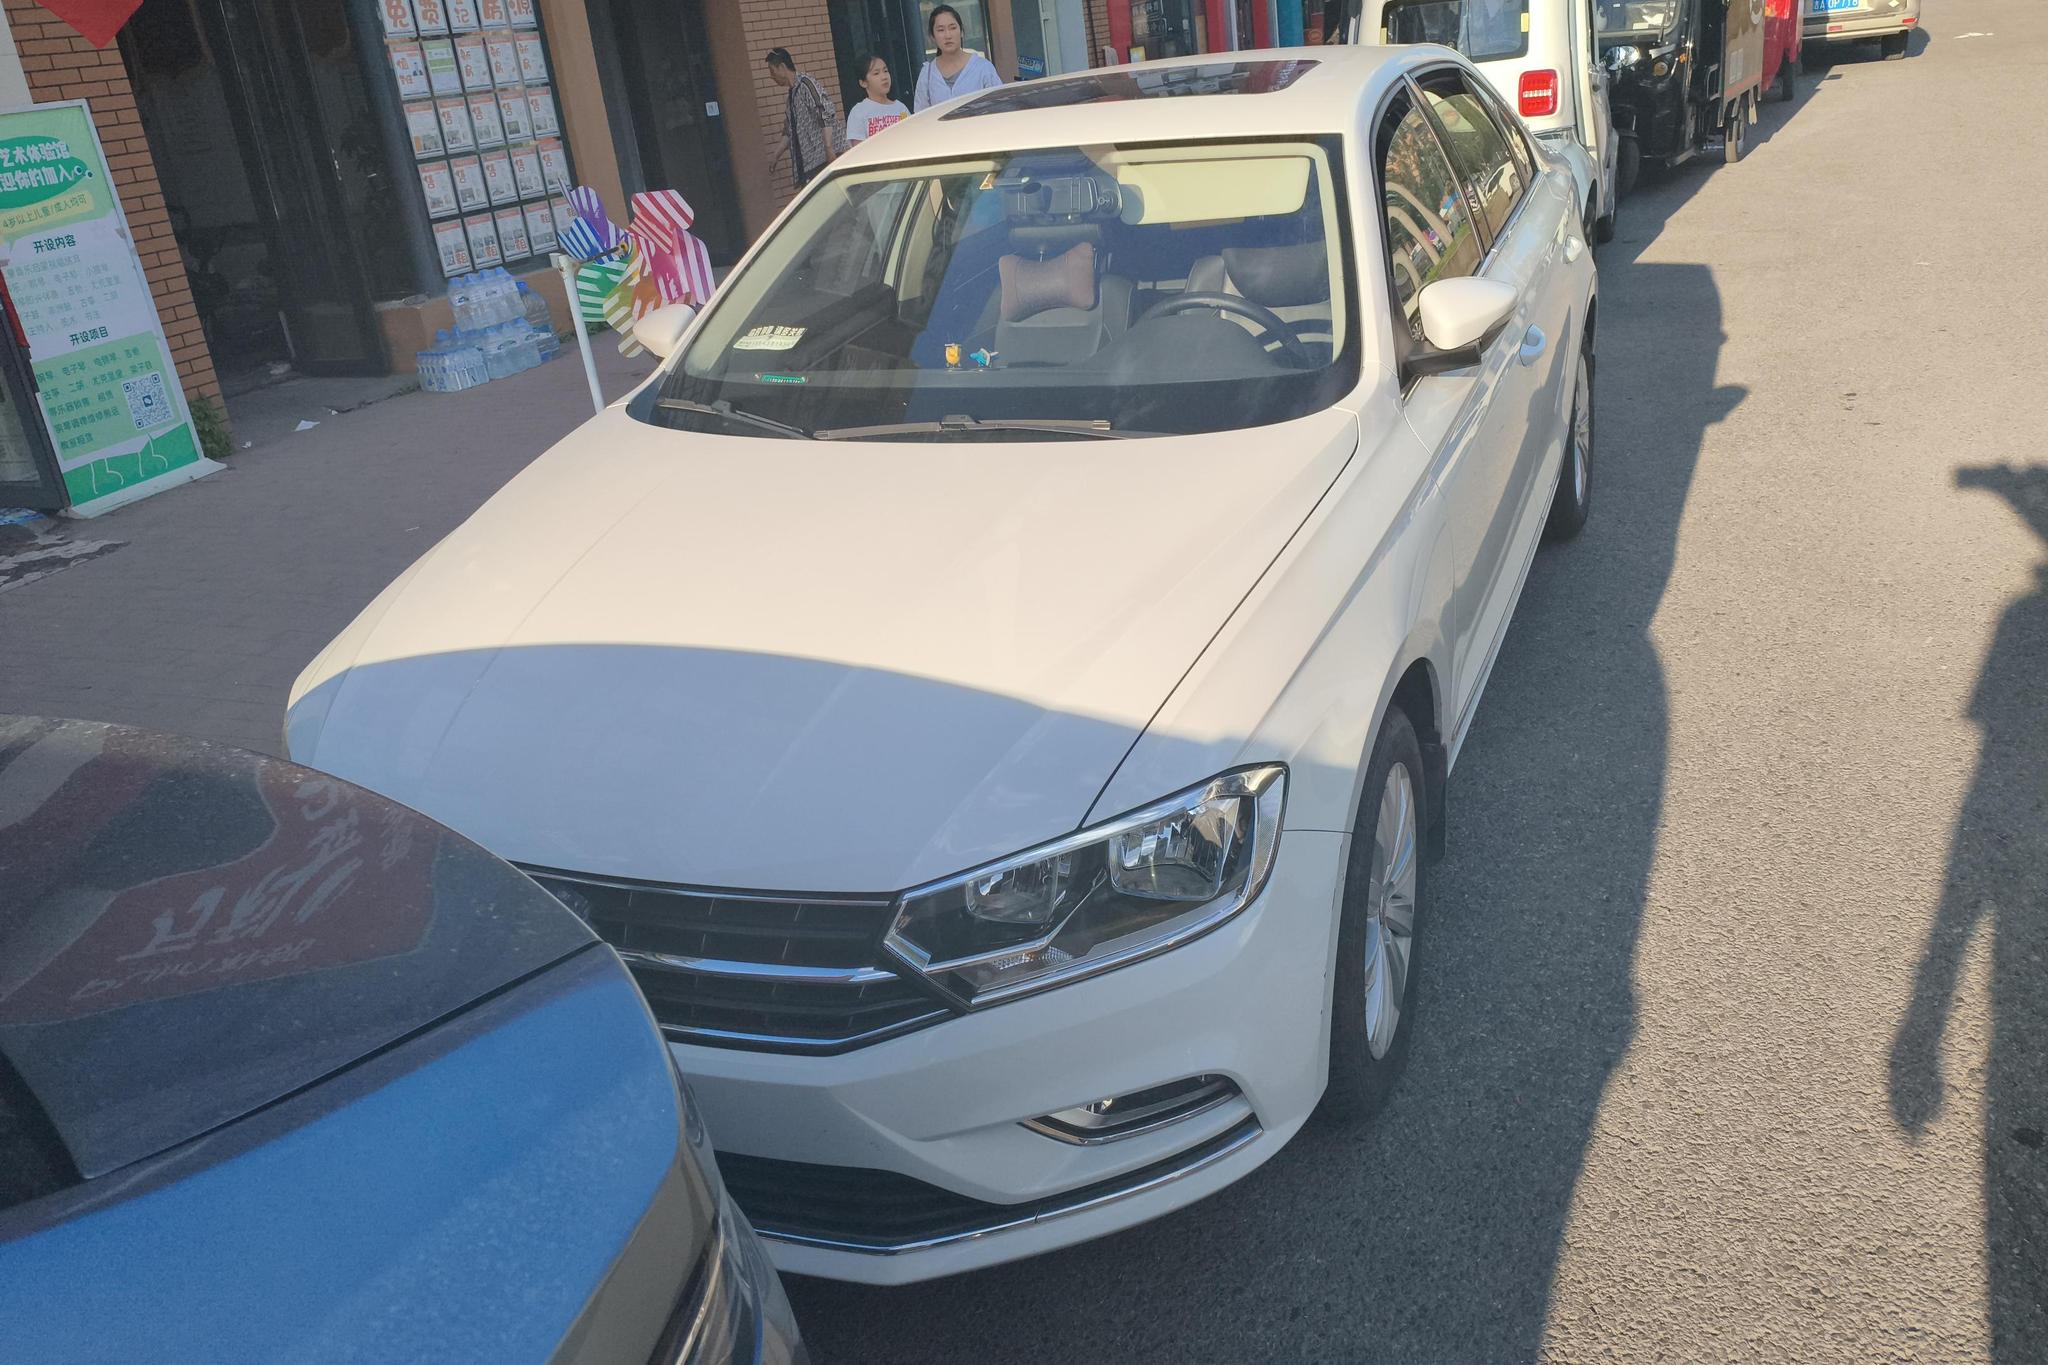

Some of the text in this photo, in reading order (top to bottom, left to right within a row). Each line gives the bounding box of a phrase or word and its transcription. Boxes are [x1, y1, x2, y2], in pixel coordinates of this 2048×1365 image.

[0, 165, 73, 192] 迎你的加入
[33, 233, 76, 253] 开设内容
[69, 326, 109, 346] 开设项目
